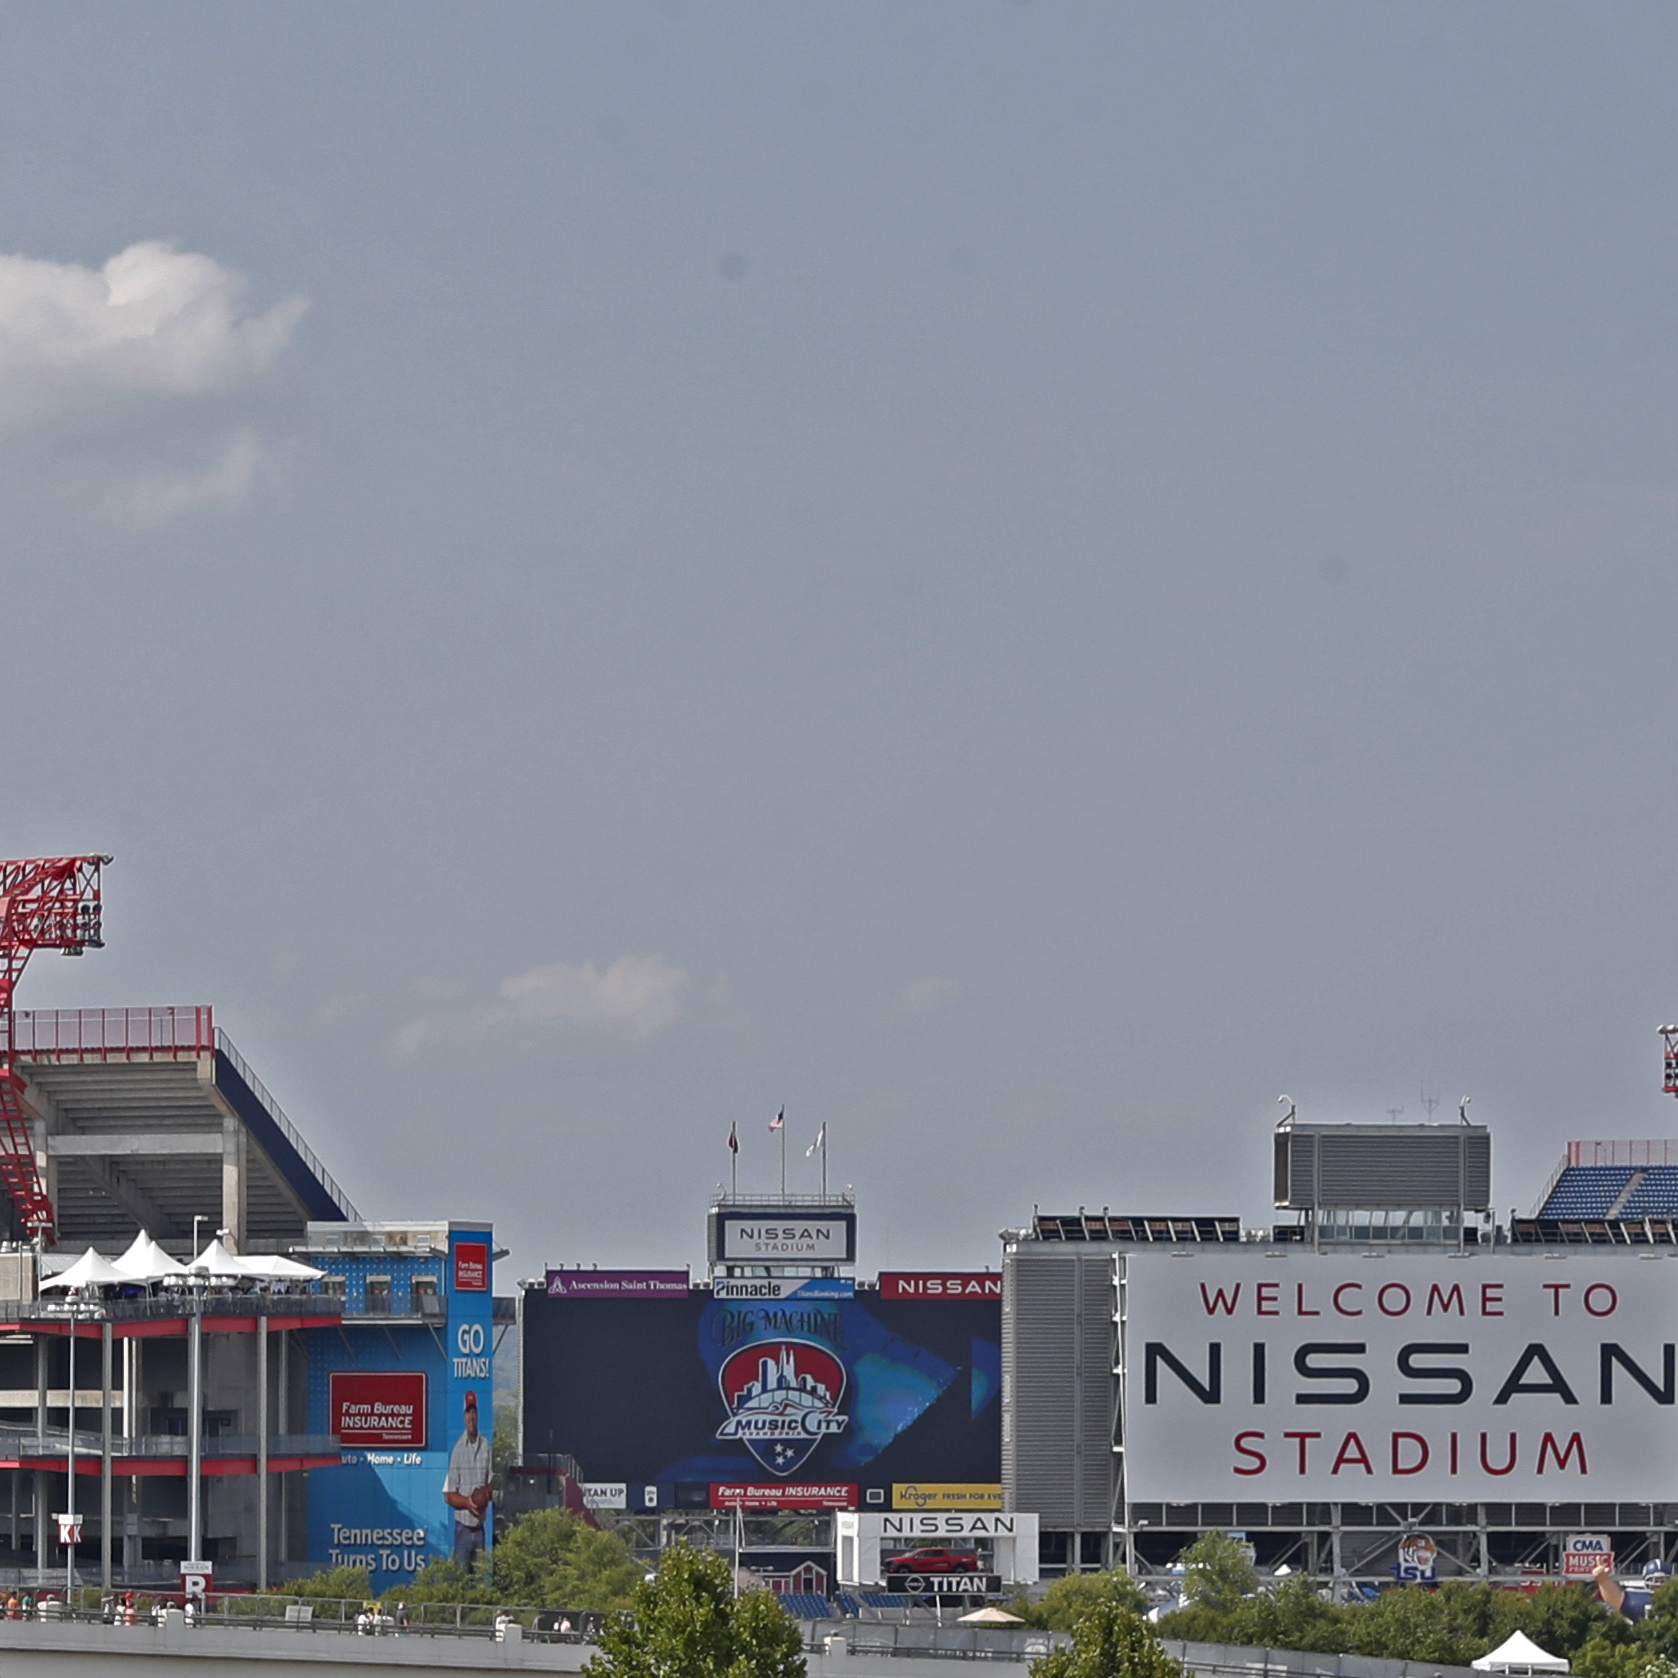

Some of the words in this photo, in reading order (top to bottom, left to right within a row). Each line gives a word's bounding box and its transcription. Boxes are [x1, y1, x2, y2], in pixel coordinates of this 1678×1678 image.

[738, 1227, 831, 1241] NISSAN
[754, 1242, 816, 1252] STADIUM
[569, 1280, 619, 1290] Ascension
[621, 1280, 647, 1290] Saint
[648, 1280, 687, 1290] Thomas
[715, 1281, 781, 1297] Pinnacle
[897, 1279, 1001, 1294] NISSAN
[1199, 1282, 1505, 1317] WELCOME
[1543, 1282, 1619, 1317] TO
[458, 1323, 484, 1354] GO
[453, 1358, 489, 1378] TITANS!
[1144, 1342, 1676, 1406] NISSAN
[342, 1402, 372, 1414] Farm
[373, 1403, 413, 1414] Bureau
[341, 1416, 413, 1429] INSURANCE
[734, 1419, 800, 1431] MUSIC
[800, 1410, 848, 1436] CITY
[341, 1453, 358, 1464] uto
[367, 1453, 394, 1464] Home
[403, 1453, 422, 1464] Life
[1233, 1430, 1590, 1477] STADIUM
[718, 1486, 744, 1496] Farm
[746, 1486, 782, 1496] Bureau
[785, 1486, 849, 1496] INSURANCE
[900, 1485, 938, 1507] Kroger
[969, 1492, 985, 1500] FOR
[883, 1517, 1014, 1533] NISSAN
[60, 1524, 71, 1543] K
[331, 1523, 424, 1545] Tennessee
[1573, 1539, 1603, 1552] CMA
[329, 1550, 376, 1571] Turns
[379, 1550, 400, 1571] To
[404, 1550, 425, 1571] Us
[1569, 1555, 1608, 1567] MUSC
[185, 1575, 207, 1599] R
[930, 1577, 986, 1591] TITAN
